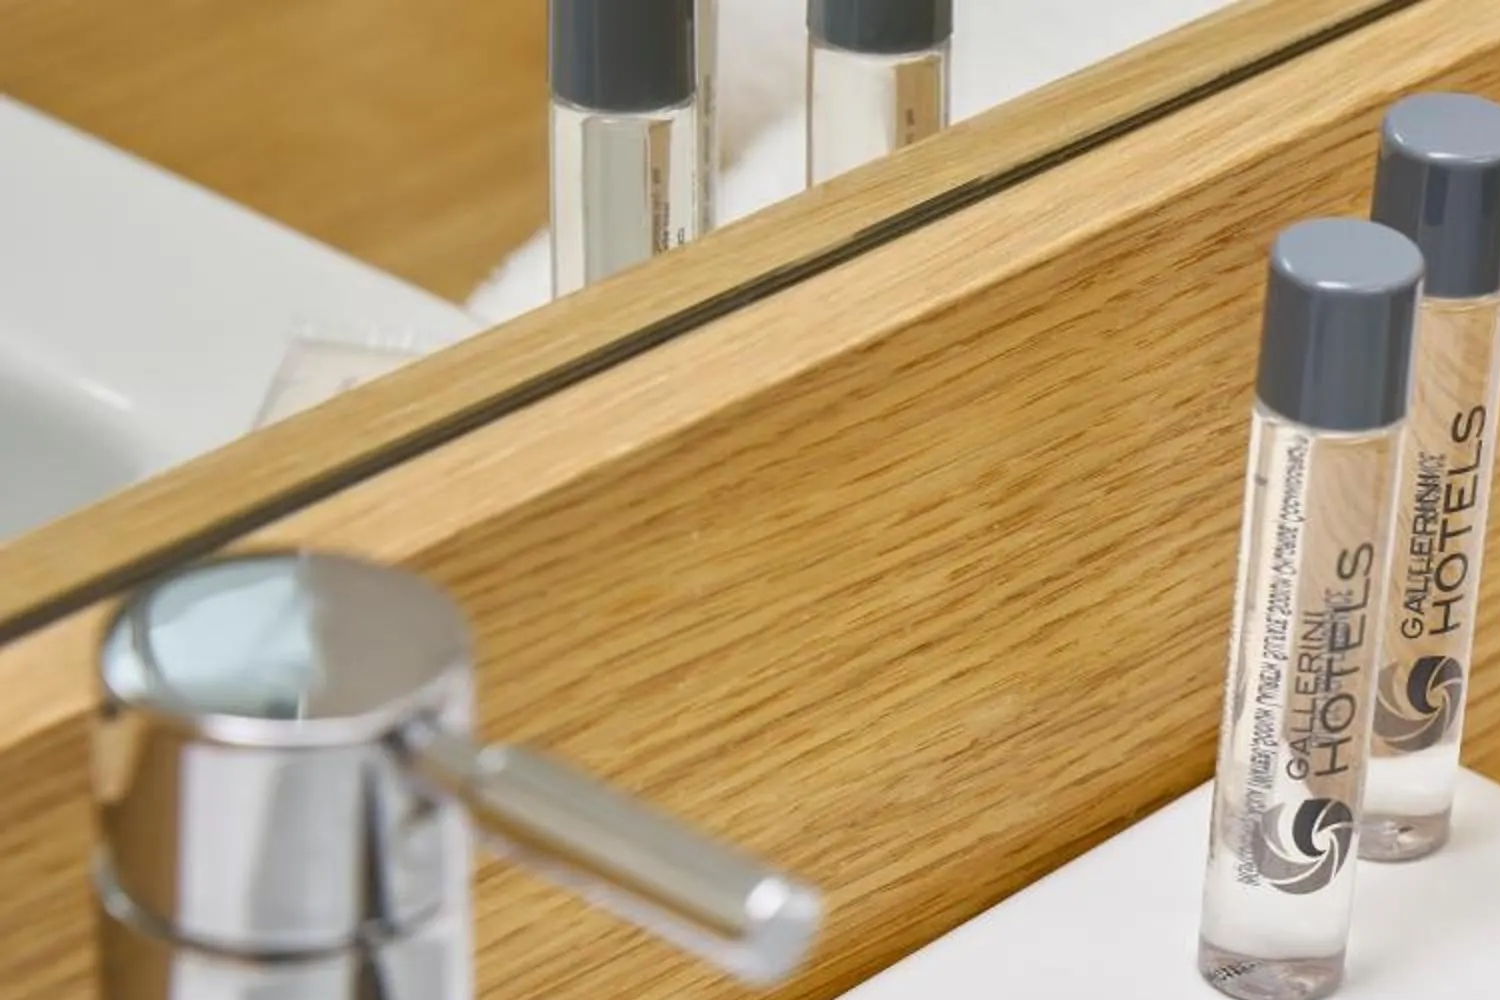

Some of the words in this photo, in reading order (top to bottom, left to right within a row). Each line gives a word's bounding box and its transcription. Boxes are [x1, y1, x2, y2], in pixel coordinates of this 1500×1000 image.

[1401, 474, 1441, 639] GALLERINI
[1429, 405, 1486, 635] HOTELS
[1286, 611, 1326, 781] GALLERINI
[1314, 542, 1374, 776] HOTELS
